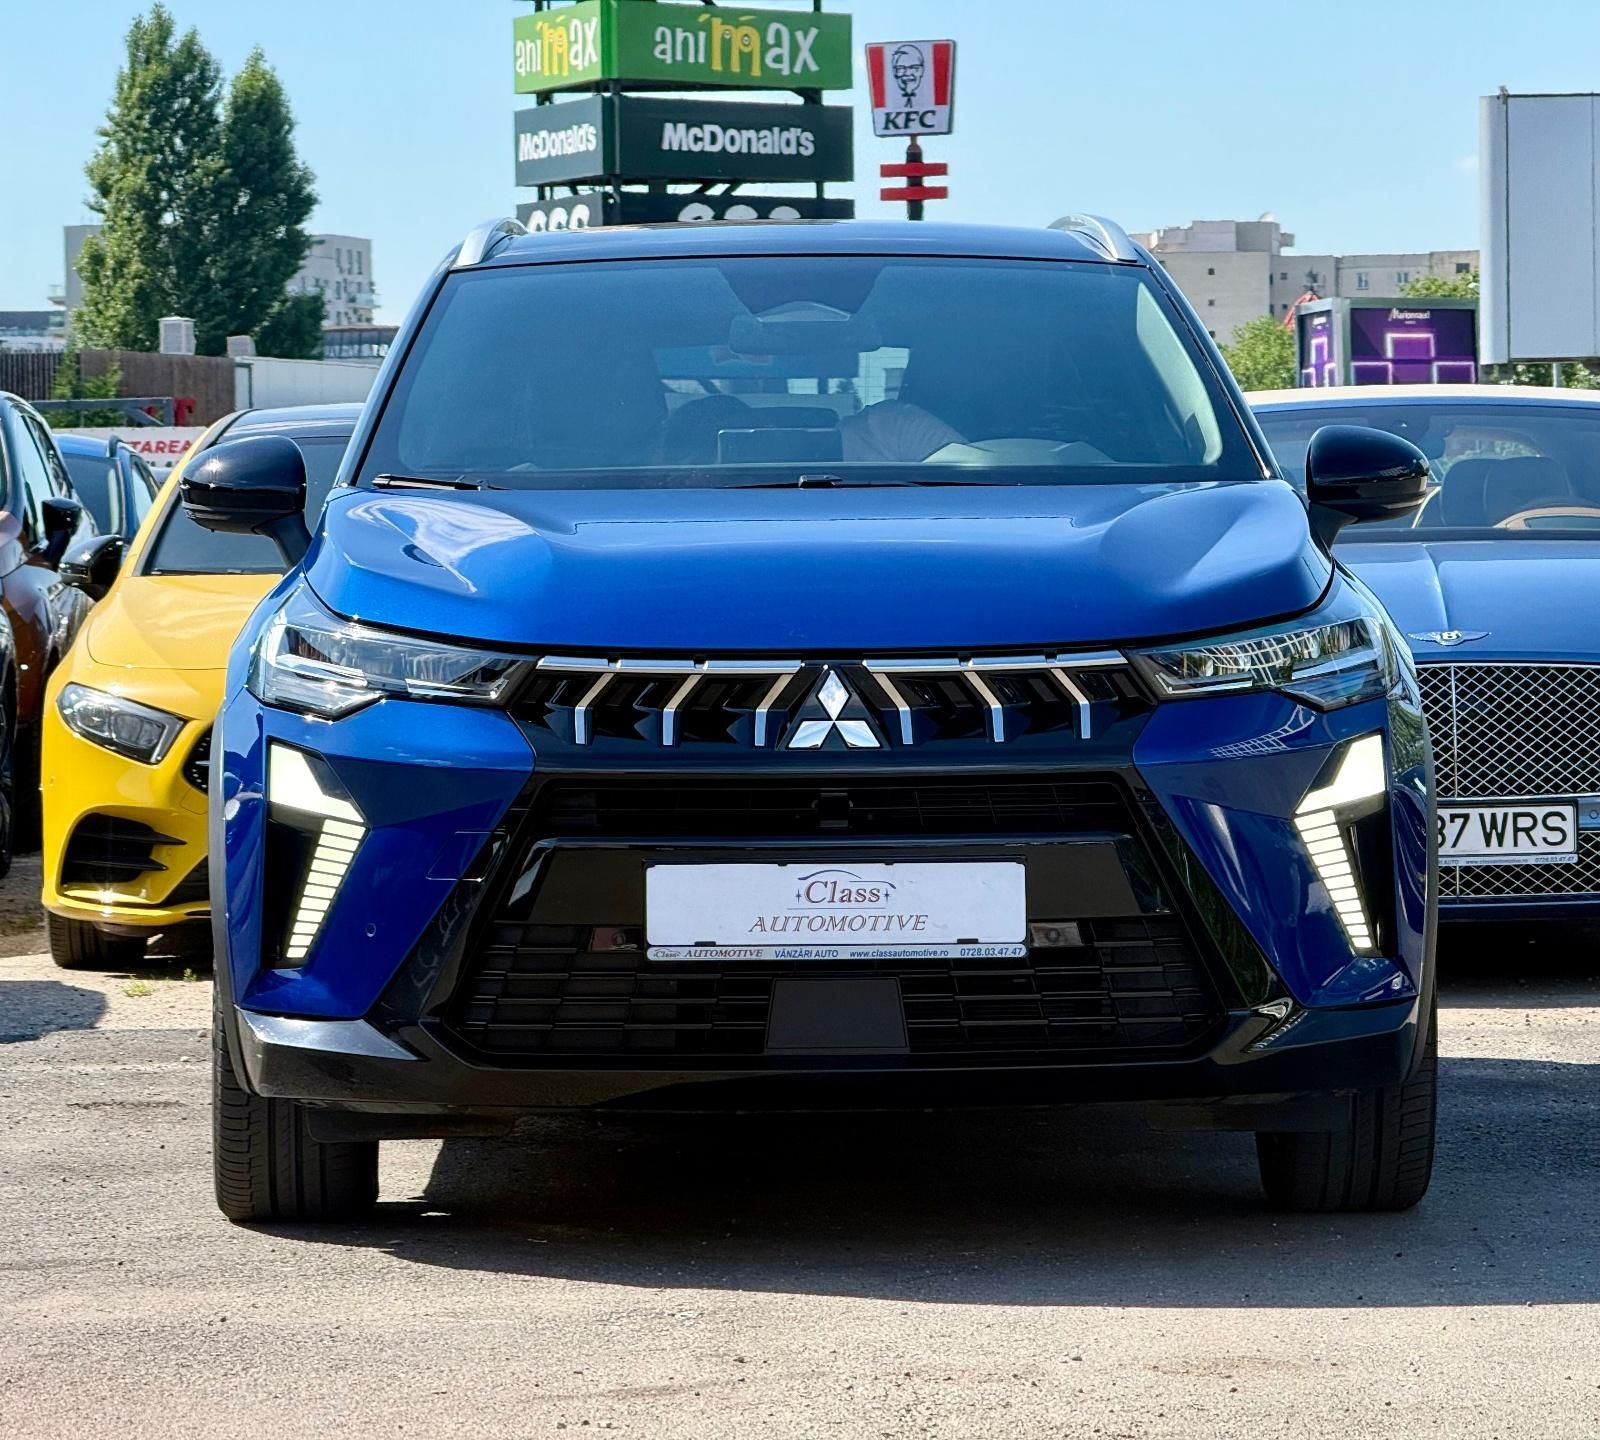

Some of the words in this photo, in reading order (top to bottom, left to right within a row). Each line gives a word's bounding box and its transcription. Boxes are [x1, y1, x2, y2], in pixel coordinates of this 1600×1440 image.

[515, 15, 598, 77] animax
[653, 15, 820, 77] animax
[882, 110, 936, 131] KFC
[518, 124, 597, 162] McDonald's
[662, 122, 815, 156] McDonald's
[1478, 811, 1567, 848] WRS
[805, 880, 881, 904] Class
[748, 915, 929, 933] AUTOMOTIVE
[684, 949, 763, 958] AUTOMOTIVE
[814, 949, 838, 958] AUTO
[849, 949, 949, 958] www.classautomotive.ro
[960, 948, 1022, 957] 0728.03.47.47
